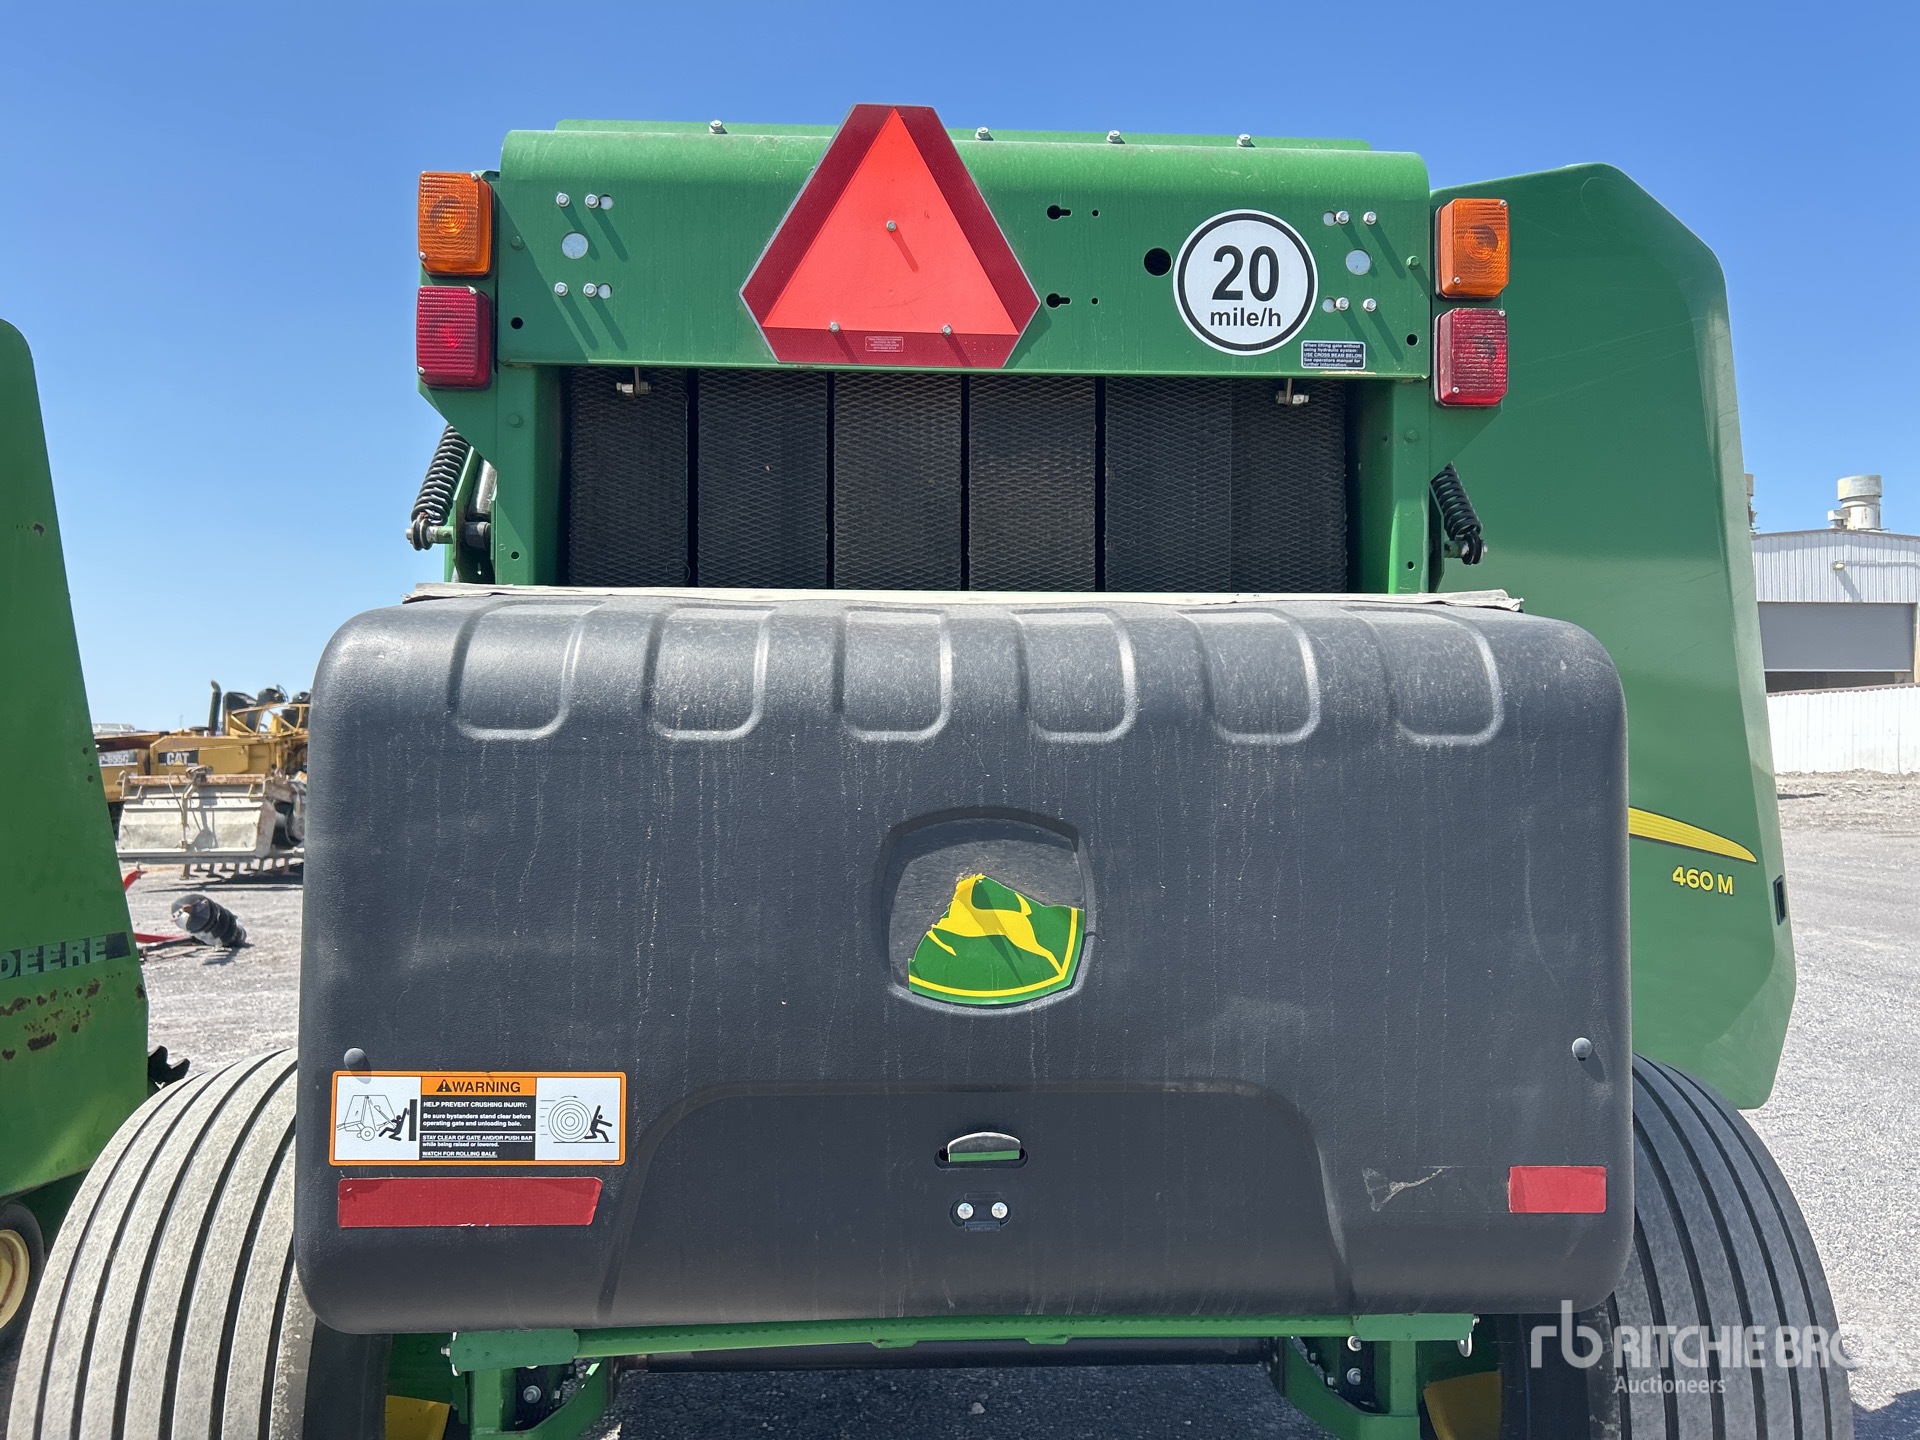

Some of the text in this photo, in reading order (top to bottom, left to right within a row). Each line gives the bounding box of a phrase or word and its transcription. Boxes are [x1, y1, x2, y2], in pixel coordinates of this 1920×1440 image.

[1211, 245, 1280, 302] 20
[1210, 307, 1282, 327] mile/h
[166, 752, 190, 766] CAT
[1672, 866, 1734, 895] 460 M
[0, 936, 107, 979] DEERE
[452, 1081, 521, 1093] WARNING
